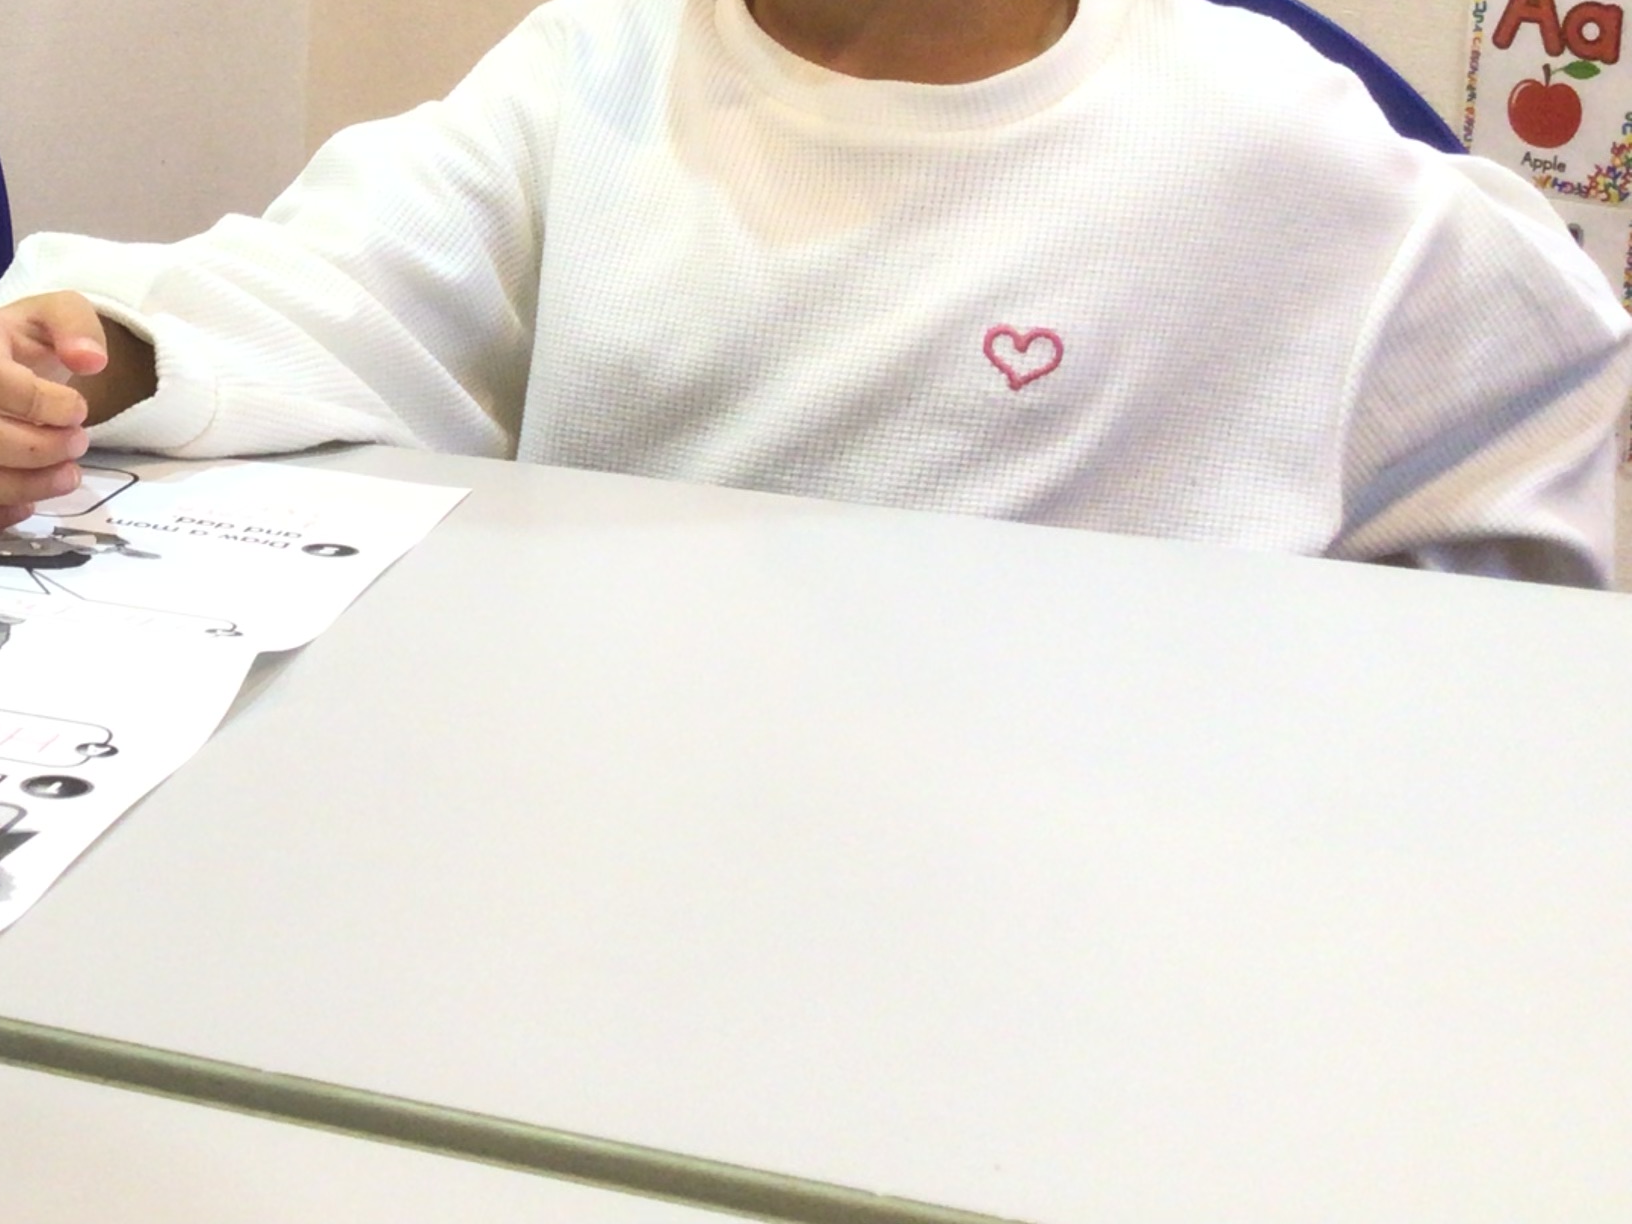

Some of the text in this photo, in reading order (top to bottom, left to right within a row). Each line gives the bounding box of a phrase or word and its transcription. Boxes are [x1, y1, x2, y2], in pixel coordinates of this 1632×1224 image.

[1520, 150, 1567, 173] Apple
[105, 516, 180, 533] mom
[188, 528, 209, 537] a
[242, 525, 303, 539] and
[218, 533, 291, 550] Draw
